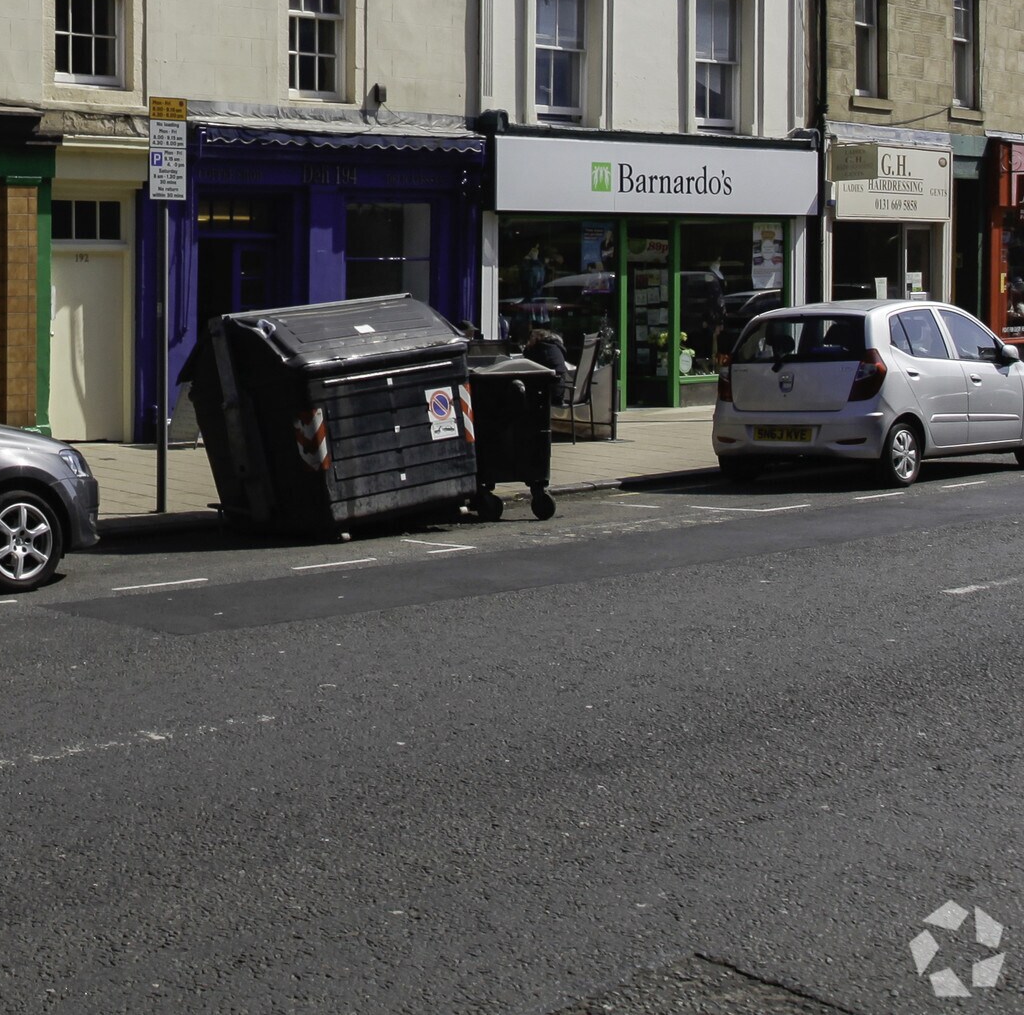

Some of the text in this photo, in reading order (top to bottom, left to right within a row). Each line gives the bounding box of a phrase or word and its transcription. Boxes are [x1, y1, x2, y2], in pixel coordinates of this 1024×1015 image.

[154, 153, 161, 165] P
[881, 153, 912, 177] G.H.
[336, 165, 358, 185] 194
[617, 162, 733, 196] Barnardo's
[843, 179, 948, 198] LADIES HAIRDRESSING GENTS
[875, 198, 918, 211] 0131 669 5858
[75, 253, 89, 263] 192
